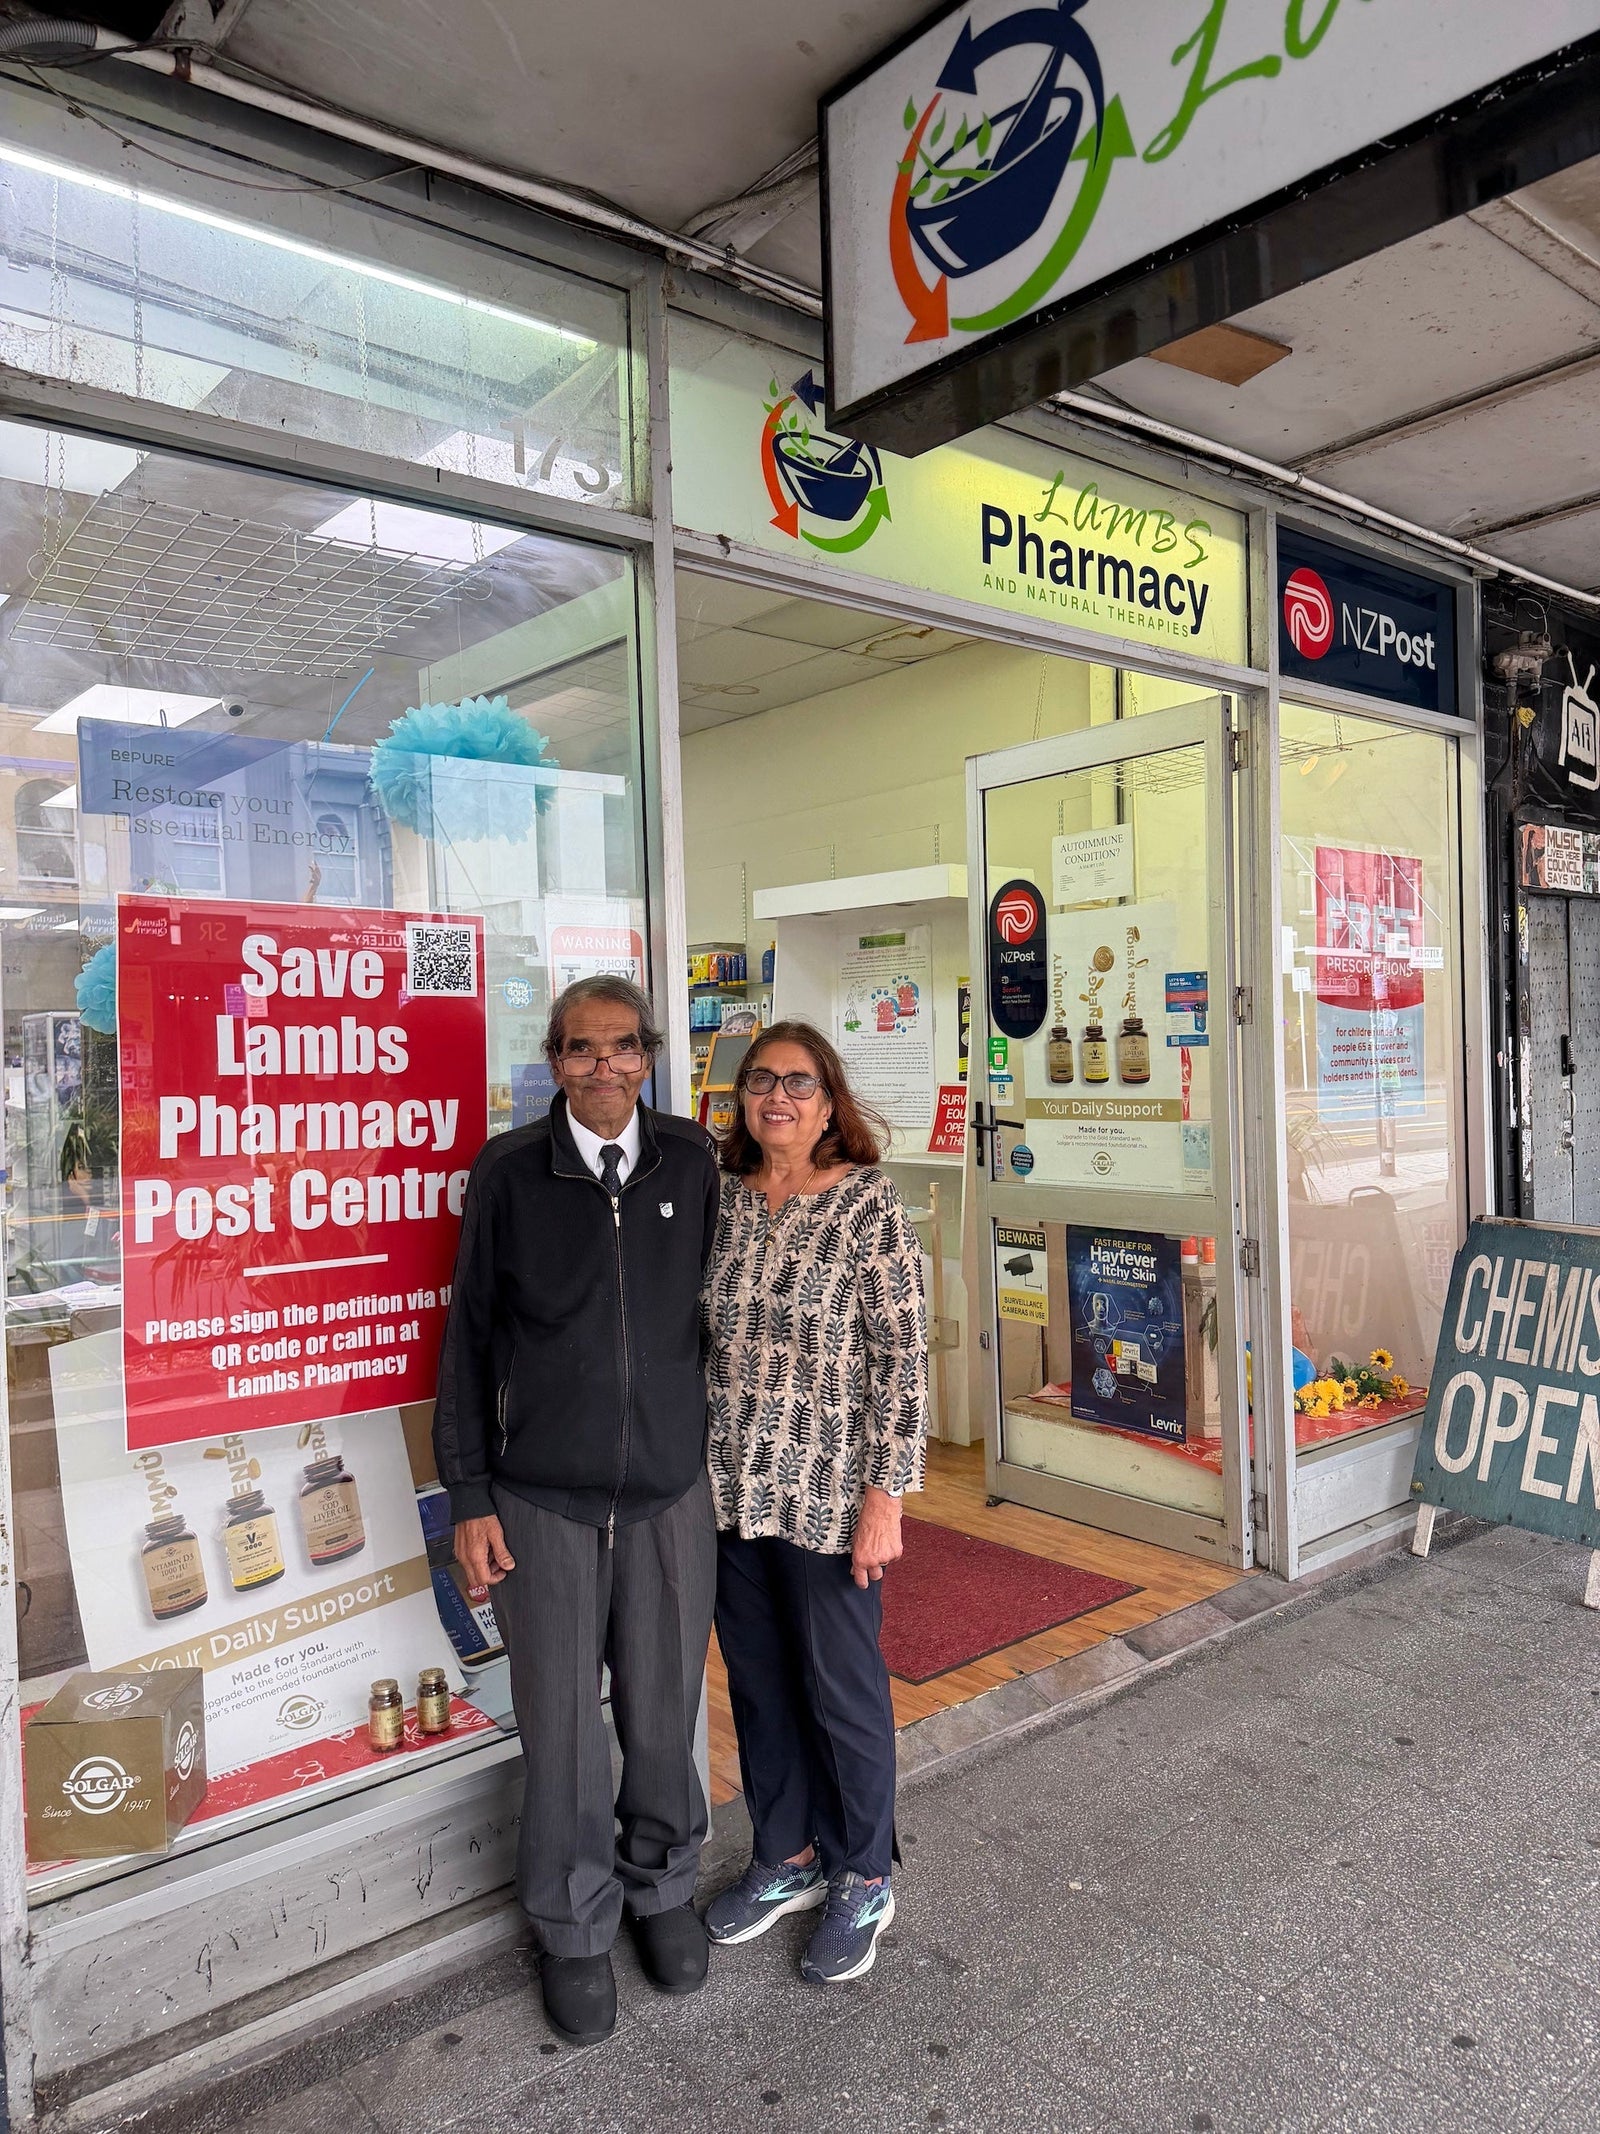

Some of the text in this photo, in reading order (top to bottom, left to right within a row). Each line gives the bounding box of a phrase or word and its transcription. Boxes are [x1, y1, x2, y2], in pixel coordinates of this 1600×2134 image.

[981, 503, 1210, 635] Pharmacy
[983, 572, 1190, 638] AND NATURAL THERAPIES
[1342, 601, 1436, 671] NZPost
[111, 778, 295, 816] Restore your
[110, 810, 356, 853] Essential Energy.
[1547, 829, 1581, 851] MUSIC
[1060, 833, 1125, 854] AUTOIMMUNE
[1547, 847, 1580, 861] LIVES HERE
[1064, 847, 1121, 866] CONDITION?
[1547, 858, 1581, 874] COUNCIL
[1547, 872, 1580, 886] SAYS NO
[1325, 896, 1415, 954] FREE
[561, 935, 632, 950] WARNING
[1126, 926, 1136, 970] VISION
[241, 934, 385, 1000] Save
[594, 958, 636, 969] 24 HOUR
[1001, 951, 1036, 964] NZPost
[1326, 956, 1414, 977] PRESCRIPTIONS
[1053, 953, 1064, 1028] IMMUNITY
[1088, 966, 1099, 1026] ENERGY
[1336, 1027, 1347, 1037] for
[216, 1014, 409, 1077] Lambs
[1332, 1041, 1409, 1054] people 65 over and
[1330, 1056, 1369, 1067] community
[1397, 1054, 1411, 1064] card
[1323, 1073, 1349, 1083] holders
[1350, 1071, 1364, 1081] and
[1043, 1101, 1163, 1118] Your Daily Support
[158, 1095, 459, 1160] Pharmacy
[1078, 1126, 1097, 1134] Made
[1098, 1126, 1108, 1134] for
[936, 1134, 946, 1146] IN
[134, 1166, 471, 1245] Post Centre
[998, 1229, 1044, 1247] BEWARE
[1094, 1237, 1152, 1252] FAST RELIEF FOR
[1090, 1245, 1157, 1269] Hayfever
[1090, 1262, 1157, 1283] & Itchy Skin
[1001, 1305, 1045, 1320] CAMERAS IN USE
[1003, 1296, 1043, 1310] SURVEILLANCE
[145, 1288, 436, 1345] Please sign the petition via
[210, 1321, 421, 1371] QR code or call in at
[227, 1352, 408, 1401] Lambs Pharmacy
[1150, 1413, 1184, 1435] Levrix
[1433, 1368, 1600, 1511] OPEN
[312, 1504, 352, 1523] LIVER OIL
[322, 1500, 339, 1511] COD
[243, 1541, 263, 1552] 2000
[246, 1531, 256, 1544] V
[151, 1557, 182, 1573] VITAMIN
[438, 1572, 451, 1587] NZ
[447, 1590, 468, 1618] PURE
[208, 1618, 279, 1660] Daily
[283, 1574, 396, 1631] Support
[231, 1641, 330, 1686] Made for you.
[244, 1641, 364, 1694] to the Gold Standard with
[231, 1680, 301, 1713] recommended
[302, 1653, 360, 1686] foundational
[360, 1648, 381, 1662] mix.
[42, 1799, 152, 1819] Since 1947
